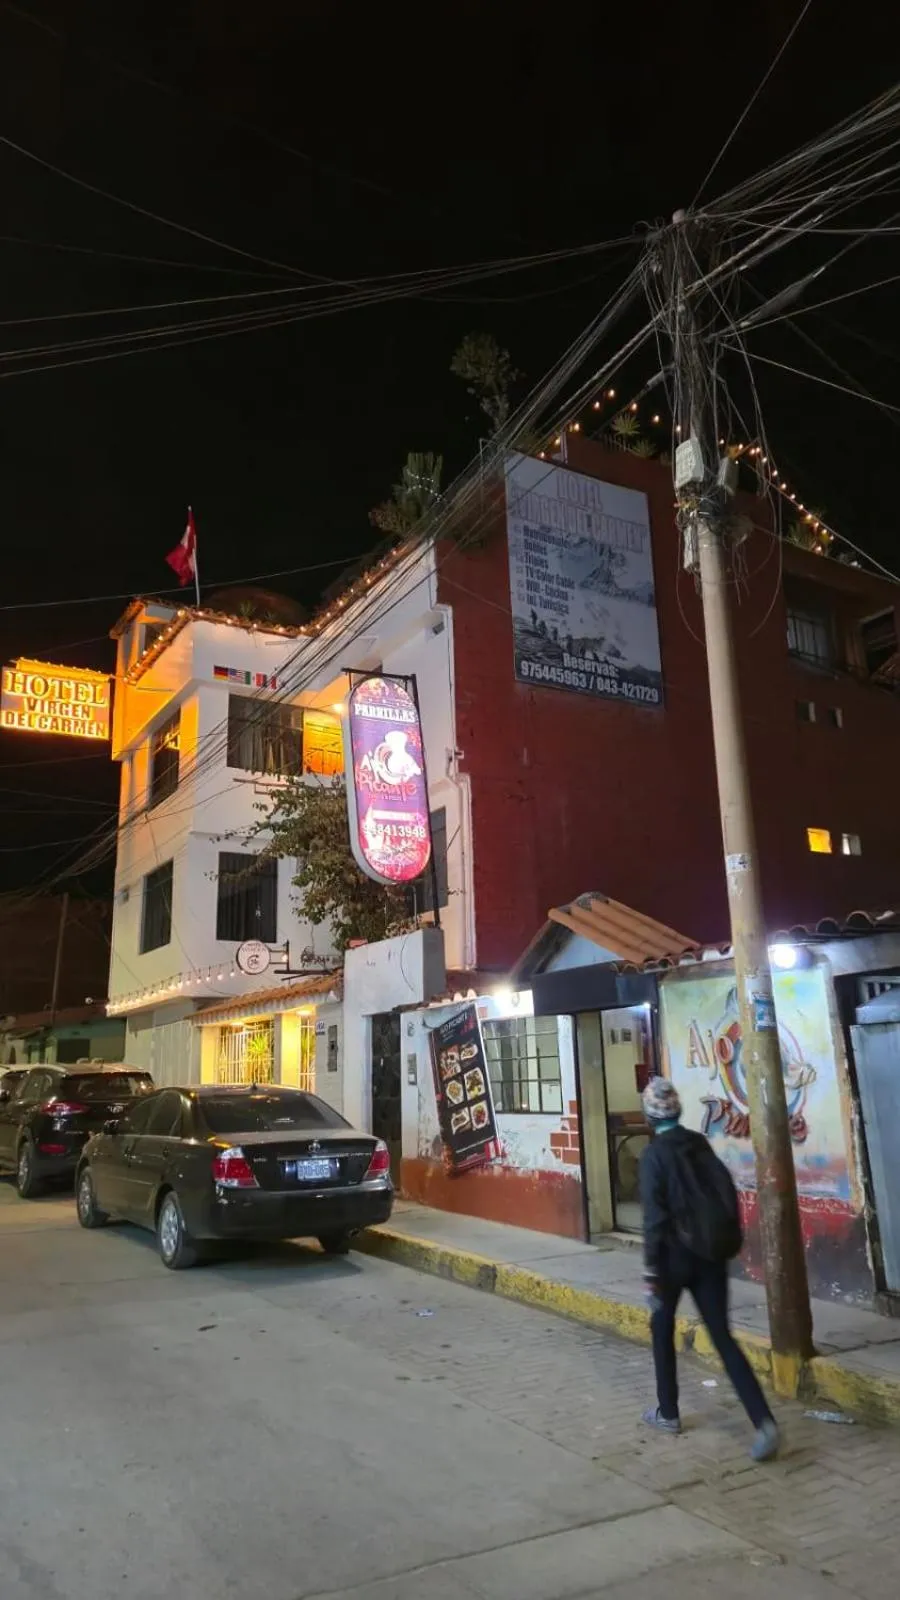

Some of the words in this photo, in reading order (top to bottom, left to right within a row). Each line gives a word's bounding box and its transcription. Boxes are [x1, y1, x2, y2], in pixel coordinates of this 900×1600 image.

[562, 652, 620, 679] Reservas:
[6, 671, 106, 706] HOTEL
[520, 660, 587, 688] 975445963
[589, 674, 594, 690] /
[596, 677, 659, 703] 043-421729
[26, 697, 92, 719] VIRGEN
[354, 703, 416, 723] PARRILLAS
[4, 711, 35, 728] DEL
[38, 714, 106, 738] CARMEN
